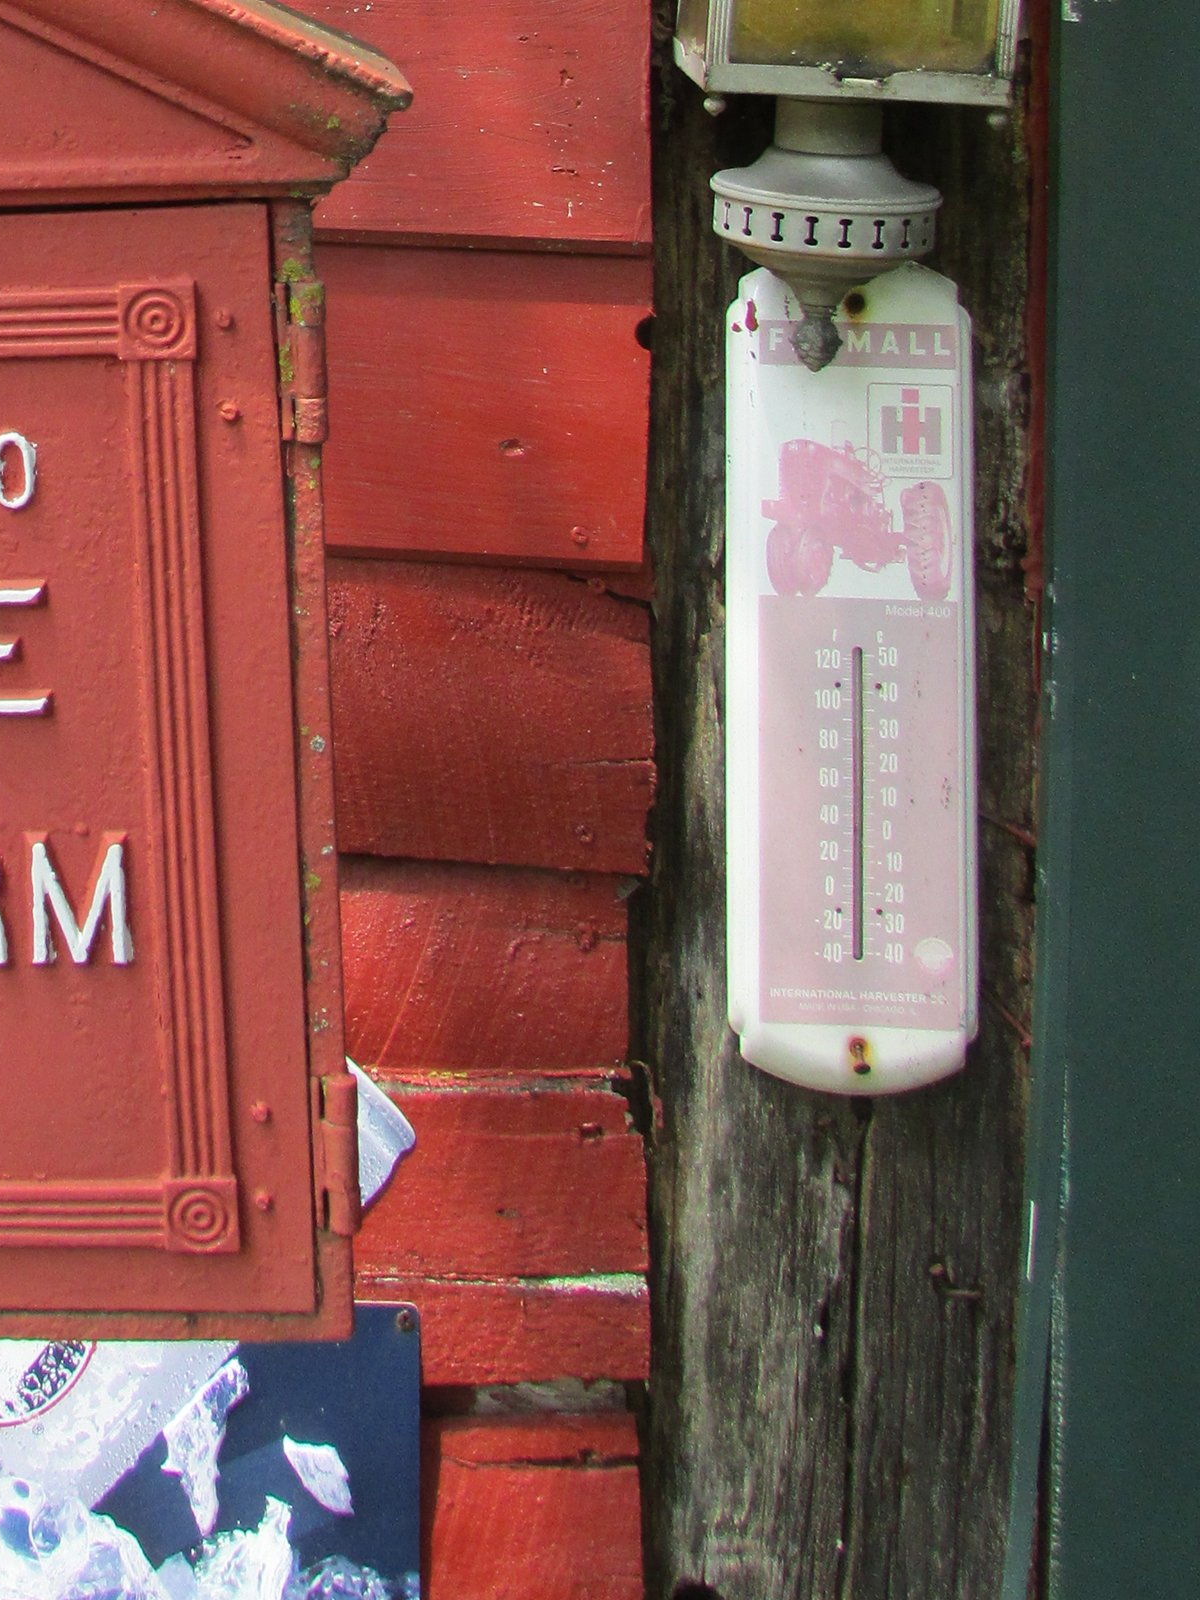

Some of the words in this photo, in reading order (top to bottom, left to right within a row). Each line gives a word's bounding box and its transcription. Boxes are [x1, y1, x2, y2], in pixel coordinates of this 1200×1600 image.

[767, 327, 951, 357] FMALL
[885, 604, 924, 617] Model
[927, 606, 951, 618] 400
[814, 648, 841, 669] 120
[878, 647, 898, 666] 50
[814, 689, 841, 709] 100
[879, 682, 898, 702] 40
[819, 728, 838, 749] 80
[879, 719, 898, 739] 30
[879, 752, 898, 773] 20
[819, 767, 839, 788] 60
[881, 787, 897, 807] 10
[820, 804, 839, 824] 40
[882, 820, 892, 840] 0
[819, 840, 838, 861] 20
[824, 875, 834, 896] 0
[769, 986, 858, 1000] INTERNATIONAL
[859, 990, 927, 1003] HARVESTER
